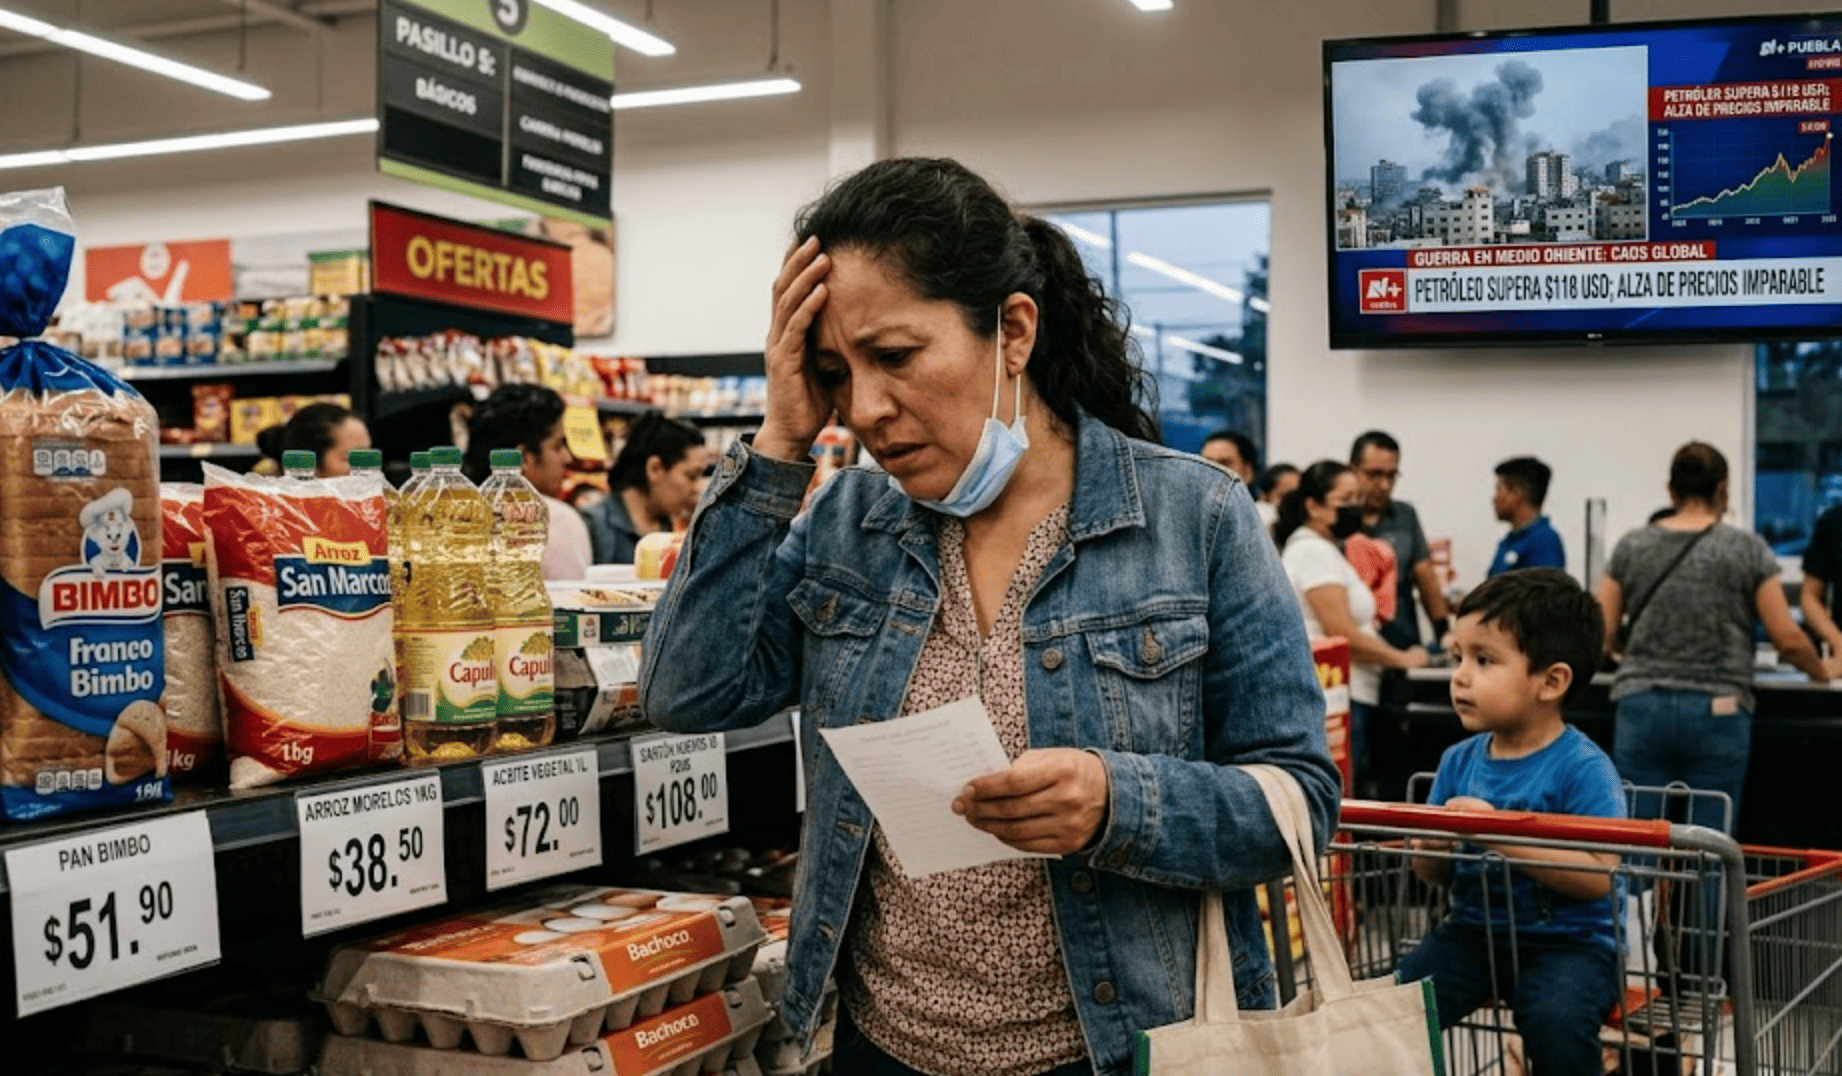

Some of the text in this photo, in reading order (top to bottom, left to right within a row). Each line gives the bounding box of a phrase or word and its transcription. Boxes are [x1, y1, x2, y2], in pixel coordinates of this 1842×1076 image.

[396, 15, 476, 68] PASILLO
[1787, 39, 1842, 54] PUEBLA
[1723, 85, 1771, 100] SUPERA
[1695, 103, 1711, 117] DE
[406, 235, 549, 300] OFERTAS
[1414, 251, 1471, 267] GUERRA
[1495, 248, 1541, 264] MEDIO
[1610, 246, 1649, 261] CAOS
[1651, 244, 1708, 260] GLOBAL
[1415, 271, 1483, 303] PETRÓLEO
[1487, 275, 1541, 302] SUPERA
[1545, 274, 1578, 303] $118
[1617, 271, 1653, 298] ALZA
[1657, 271, 1675, 297] DE
[1678, 269, 1738, 297] PRECIOS
[1743, 267, 1825, 296] IMPARABLE
[53, 577, 159, 612] BIMBO
[280, 565, 328, 598] San
[70, 637, 154, 666] Franco
[70, 664, 154, 697] Bimbo
[531, 758, 574, 781] VEGETAL
[305, 797, 351, 822] ARROZ
[59, 834, 151, 871] PAN BIMBO
[627, 930, 690, 962] Bachoco
[635, 1013, 700, 1049] Bachoco
